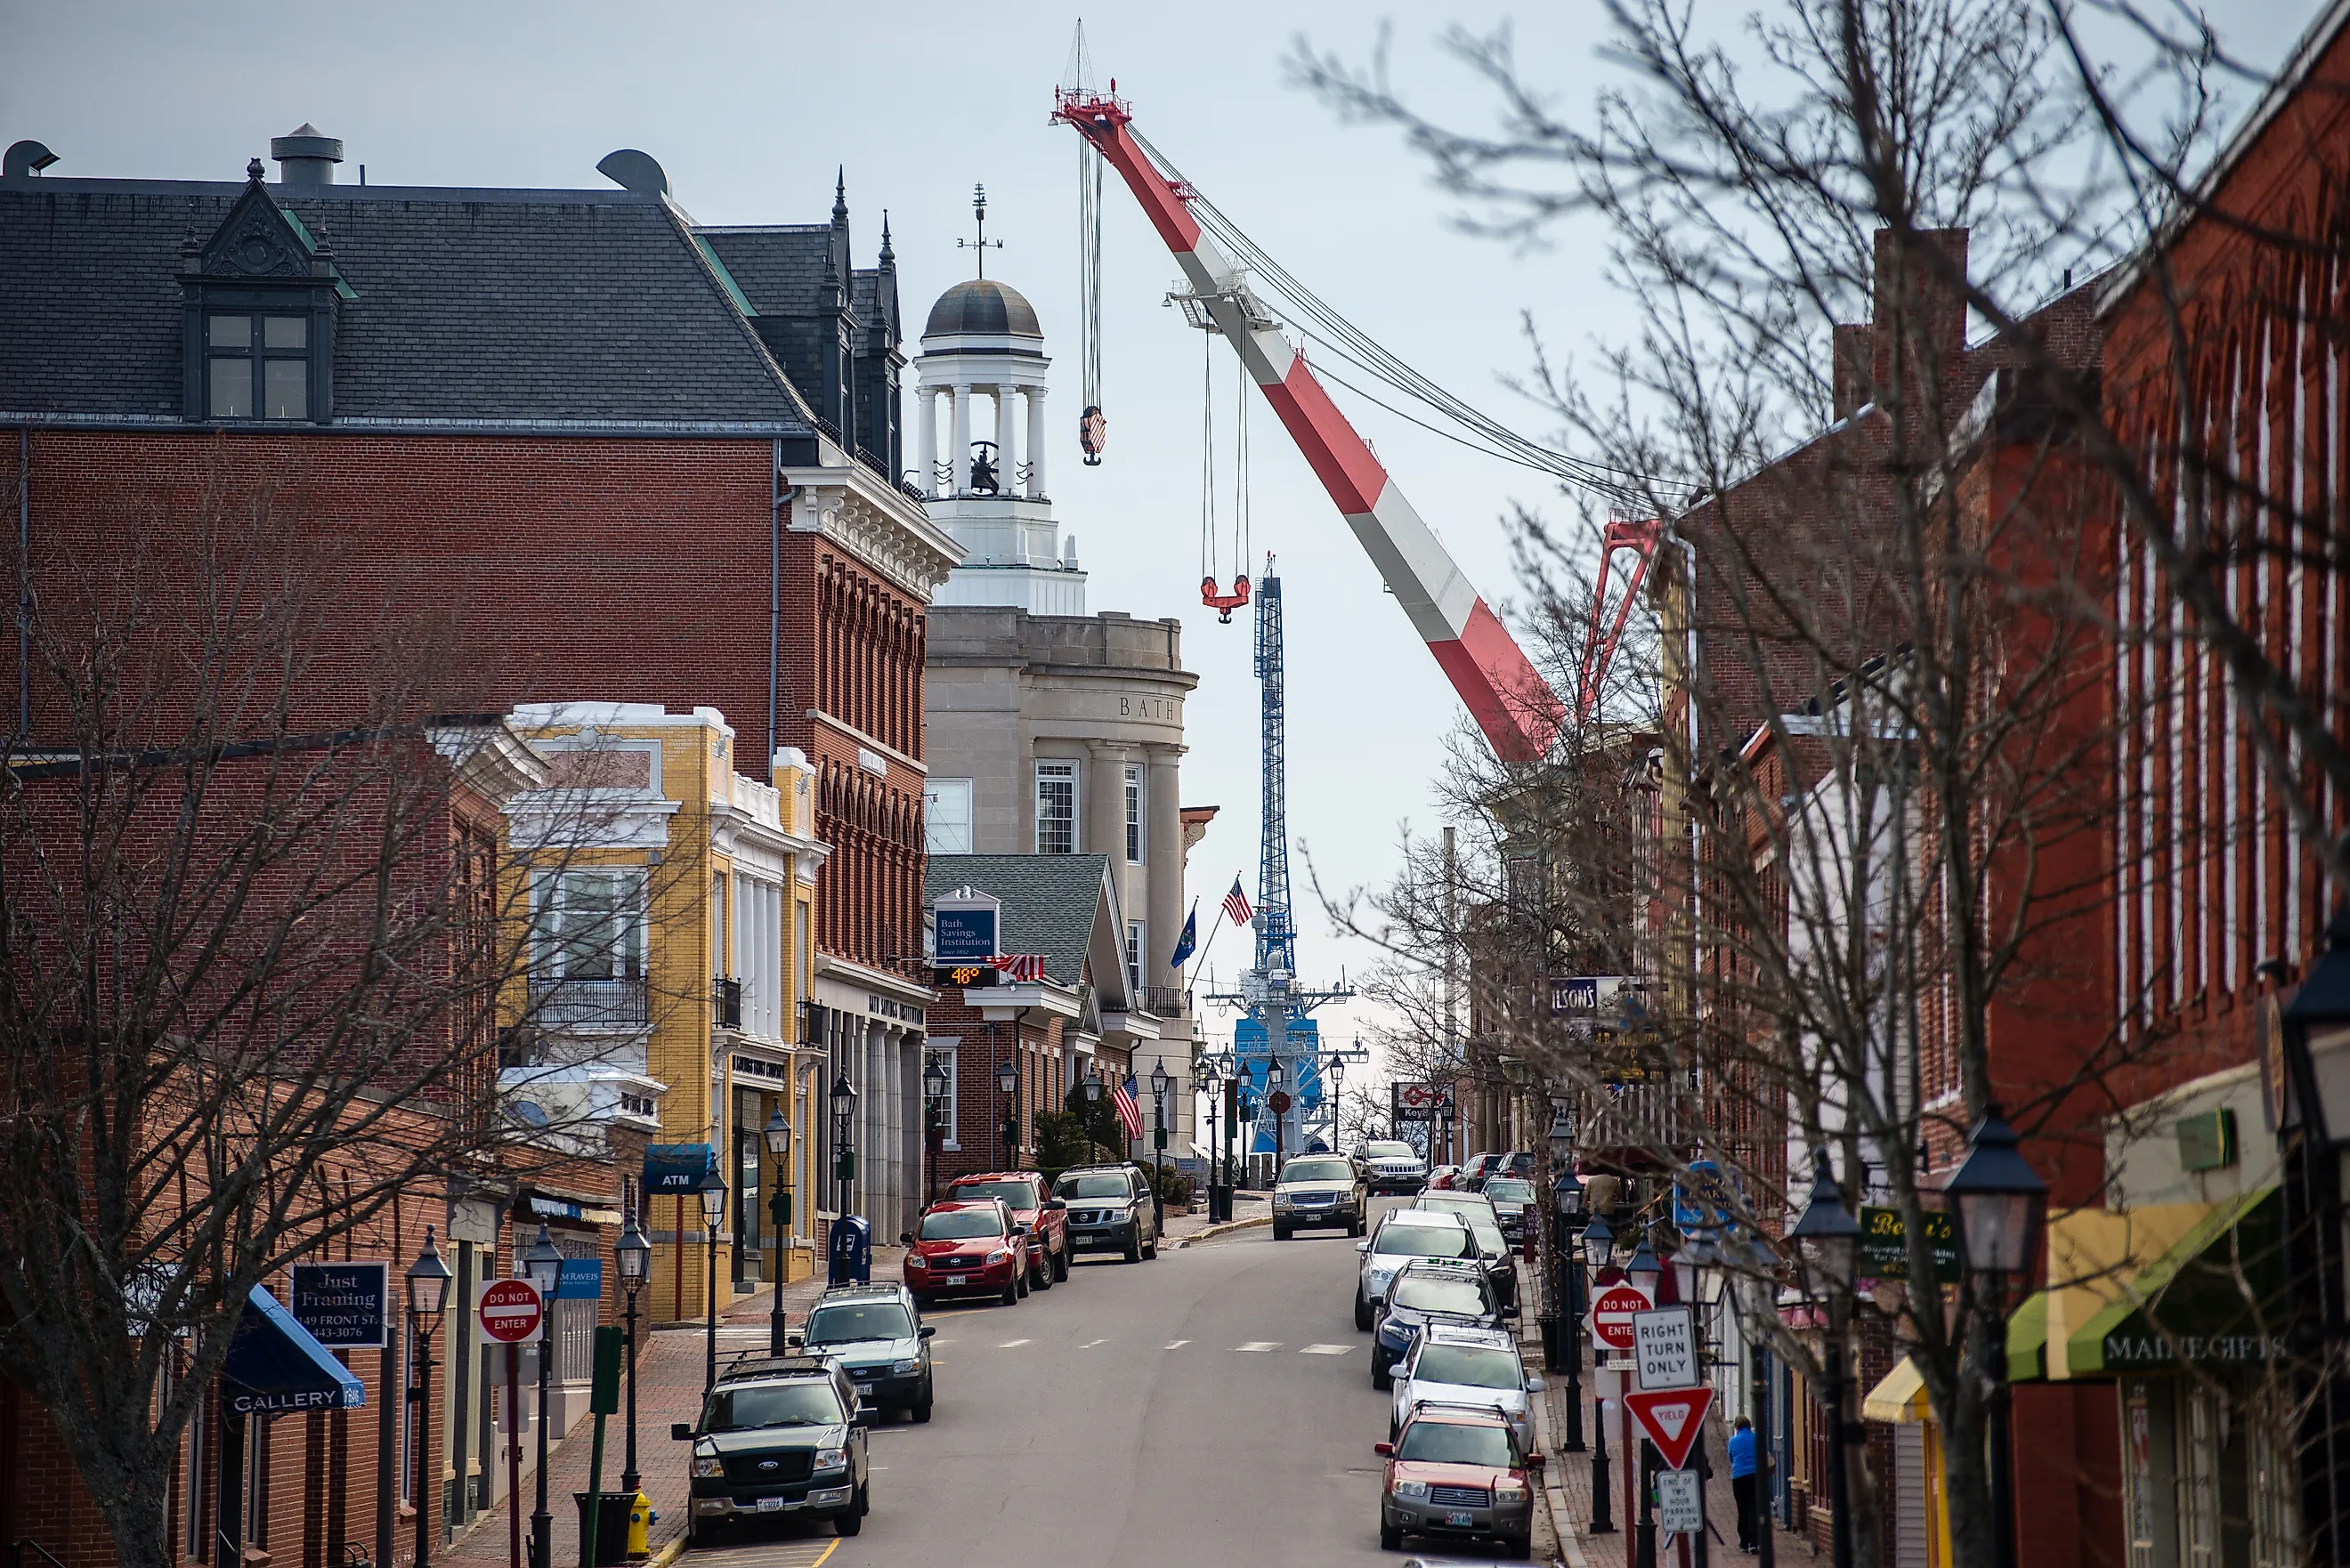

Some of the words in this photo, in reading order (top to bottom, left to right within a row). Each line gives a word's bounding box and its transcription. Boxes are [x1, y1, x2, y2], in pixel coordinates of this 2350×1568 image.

[1120, 697, 1173, 720] BATH
[941, 919, 962, 928] Bath
[941, 928, 976, 939] Savings
[941, 938, 991, 946] Institution
[1552, 985, 1595, 1009] ILSON'S
[661, 1175, 689, 1185] ATM
[318, 1273, 359, 1289] Just
[571, 1272, 599, 1281] RAVEIS
[302, 1291, 376, 1310] Framing
[490, 1294, 505, 1304] DO
[508, 1292, 530, 1303] NOT
[1603, 1300, 1618, 1310] DO
[1621, 1300, 1642, 1310] NOT
[298, 1315, 317, 1325] 149
[320, 1315, 359, 1325] FRONT
[361, 1314, 378, 1325] ST.
[494, 1319, 527, 1330] ENTER
[312, 1327, 363, 1338] 443-3076
[1608, 1326, 1633, 1336] ENTE
[1641, 1323, 1684, 1339] RIGHT
[1646, 1342, 1685, 1356] TURN
[1647, 1360, 1686, 1375] ONLY
[234, 1390, 336, 1411] GALLERY
[1658, 1410, 1684, 1421] YIELD
[1663, 1479, 1678, 1487] END
[1682, 1478, 1692, 1486] OF
[1665, 1507, 1698, 1515] PARKING
